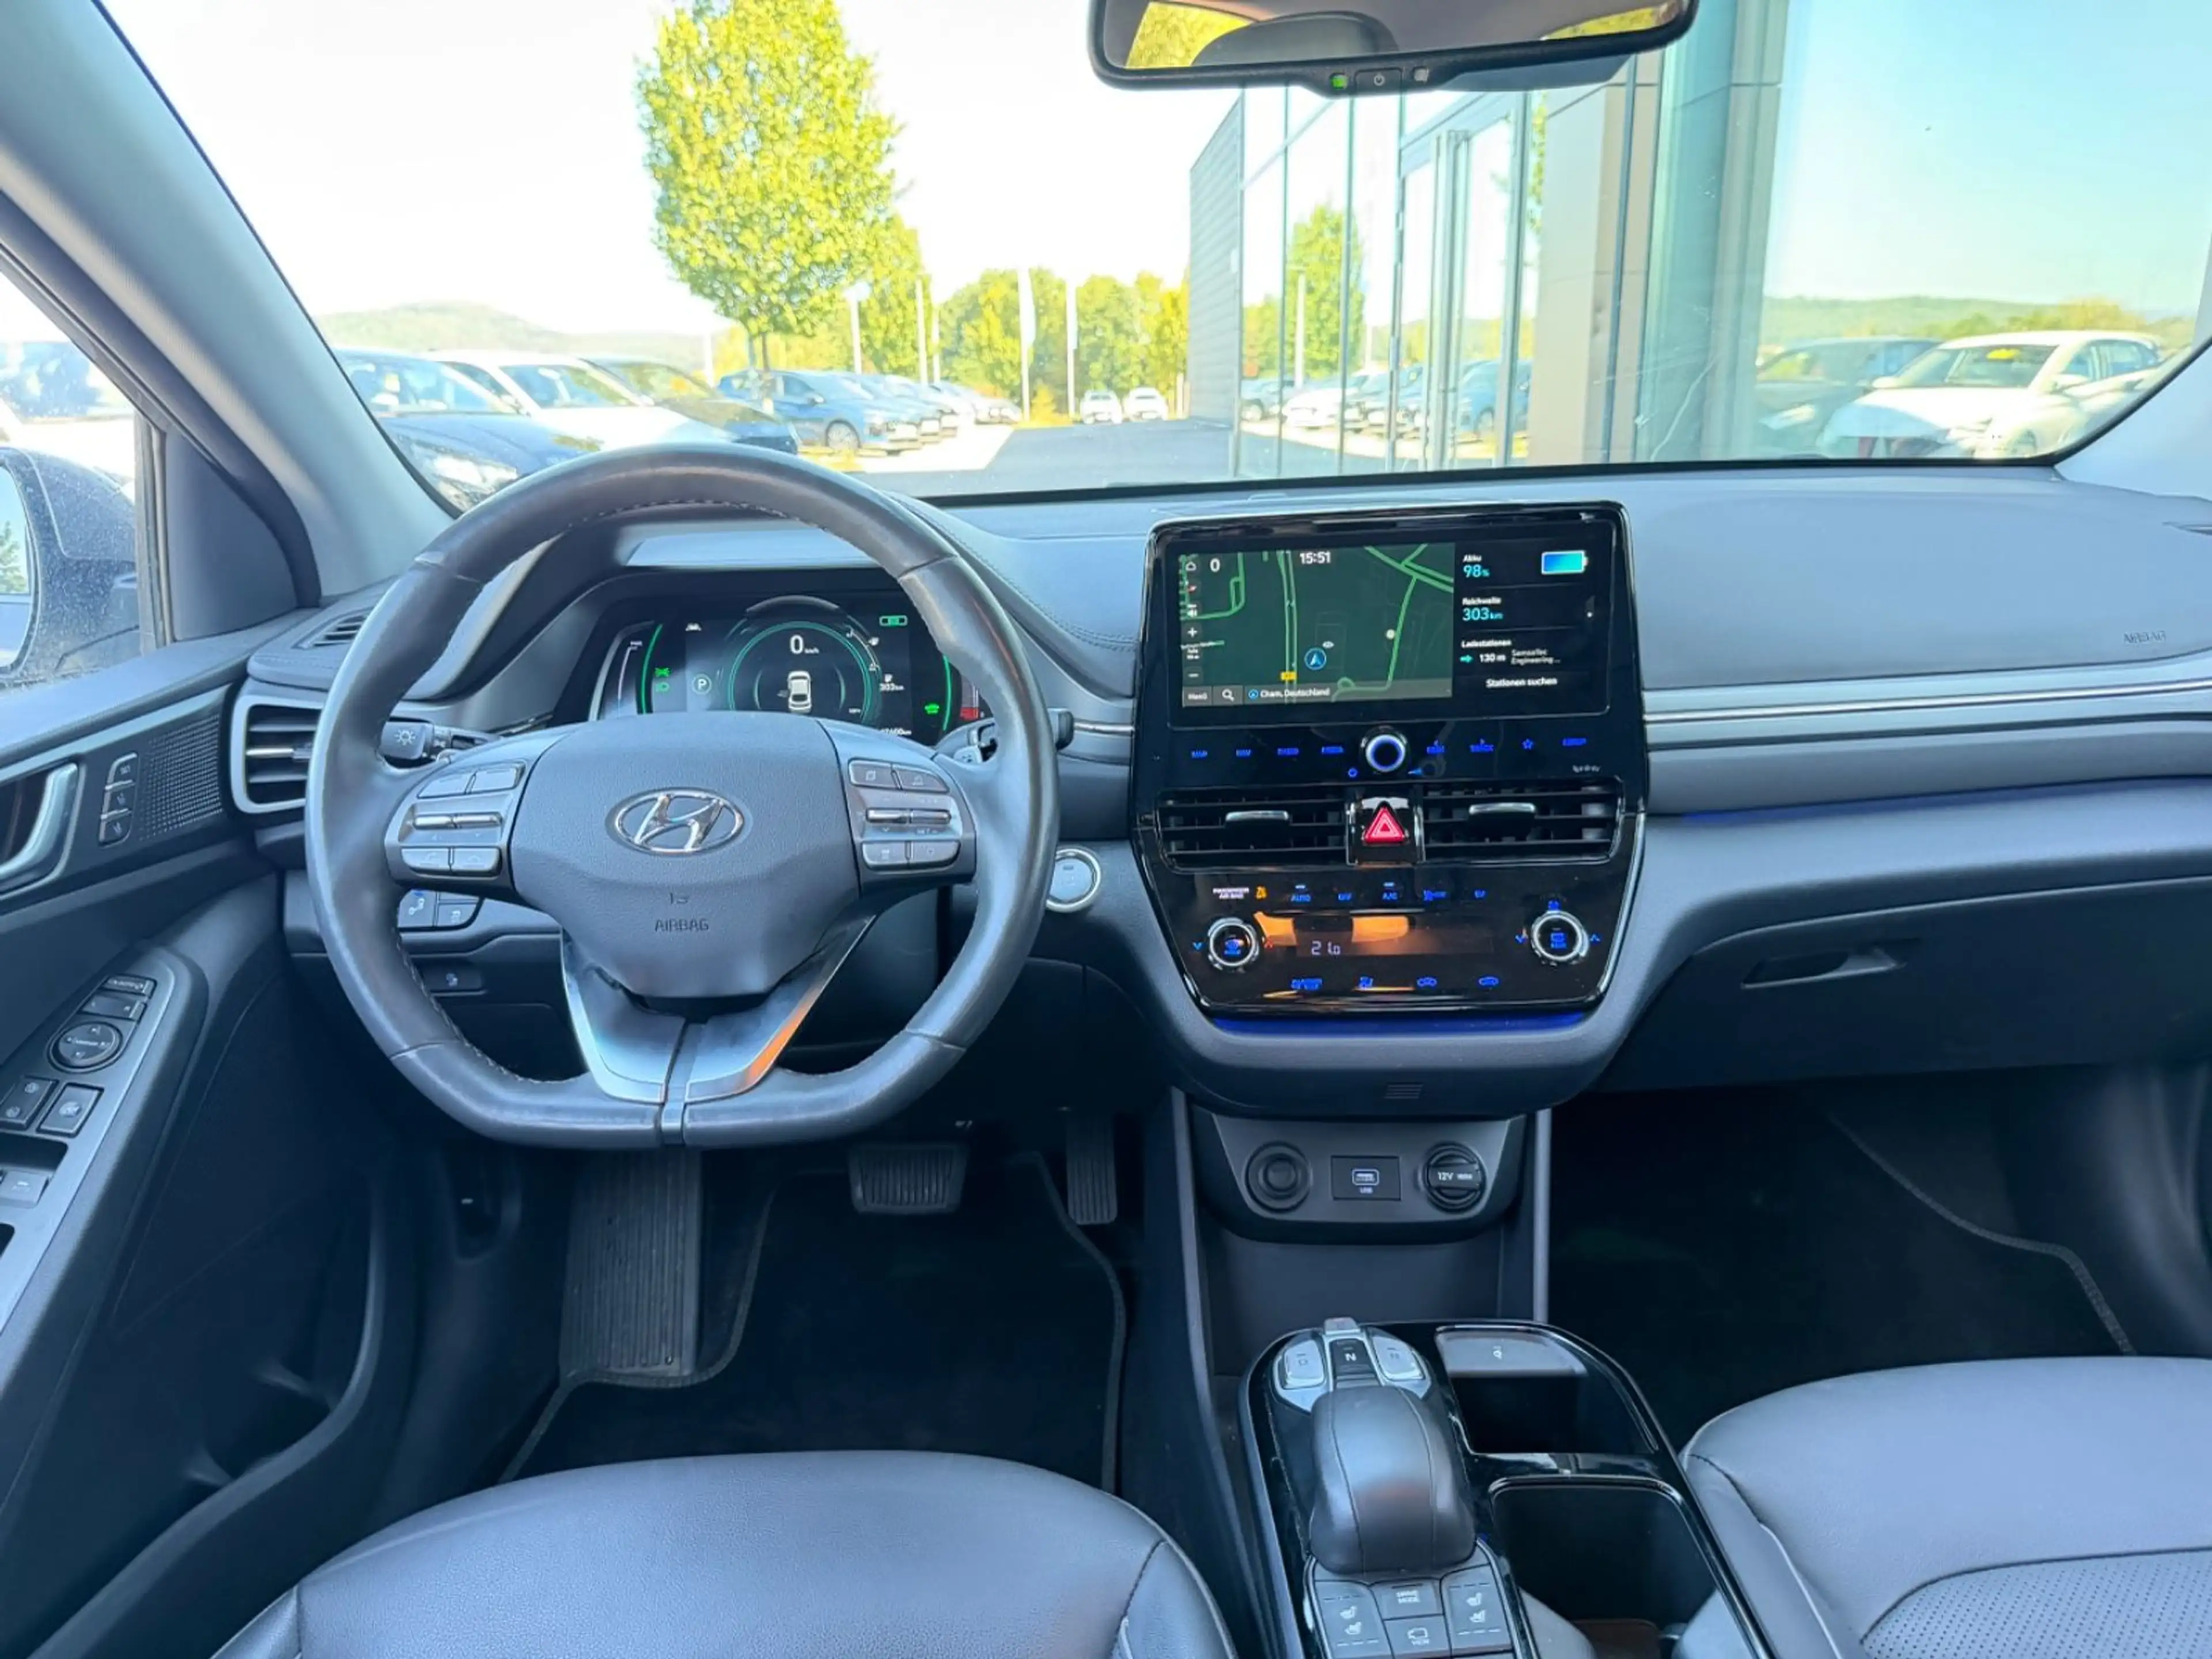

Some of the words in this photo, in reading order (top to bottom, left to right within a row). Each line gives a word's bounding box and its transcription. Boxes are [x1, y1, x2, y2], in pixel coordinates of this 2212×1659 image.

[1300, 551, 1332, 565] 15:51
[1463, 554, 1482, 562] Akku
[1210, 558, 1221, 573] 0
[1462, 596, 1502, 605] Reichweite
[789, 634, 804, 654] 0
[1461, 639, 1512, 649] Ladestationen
[1479, 653, 1495, 662] 130
[1485, 677, 1526, 688] Stationen
[1527, 676, 1558, 687] suchen
[654, 918, 709, 933] AIRBAG
[1438, 1172, 1454, 1180] 12V
[1344, 1353, 1357, 1362] N
